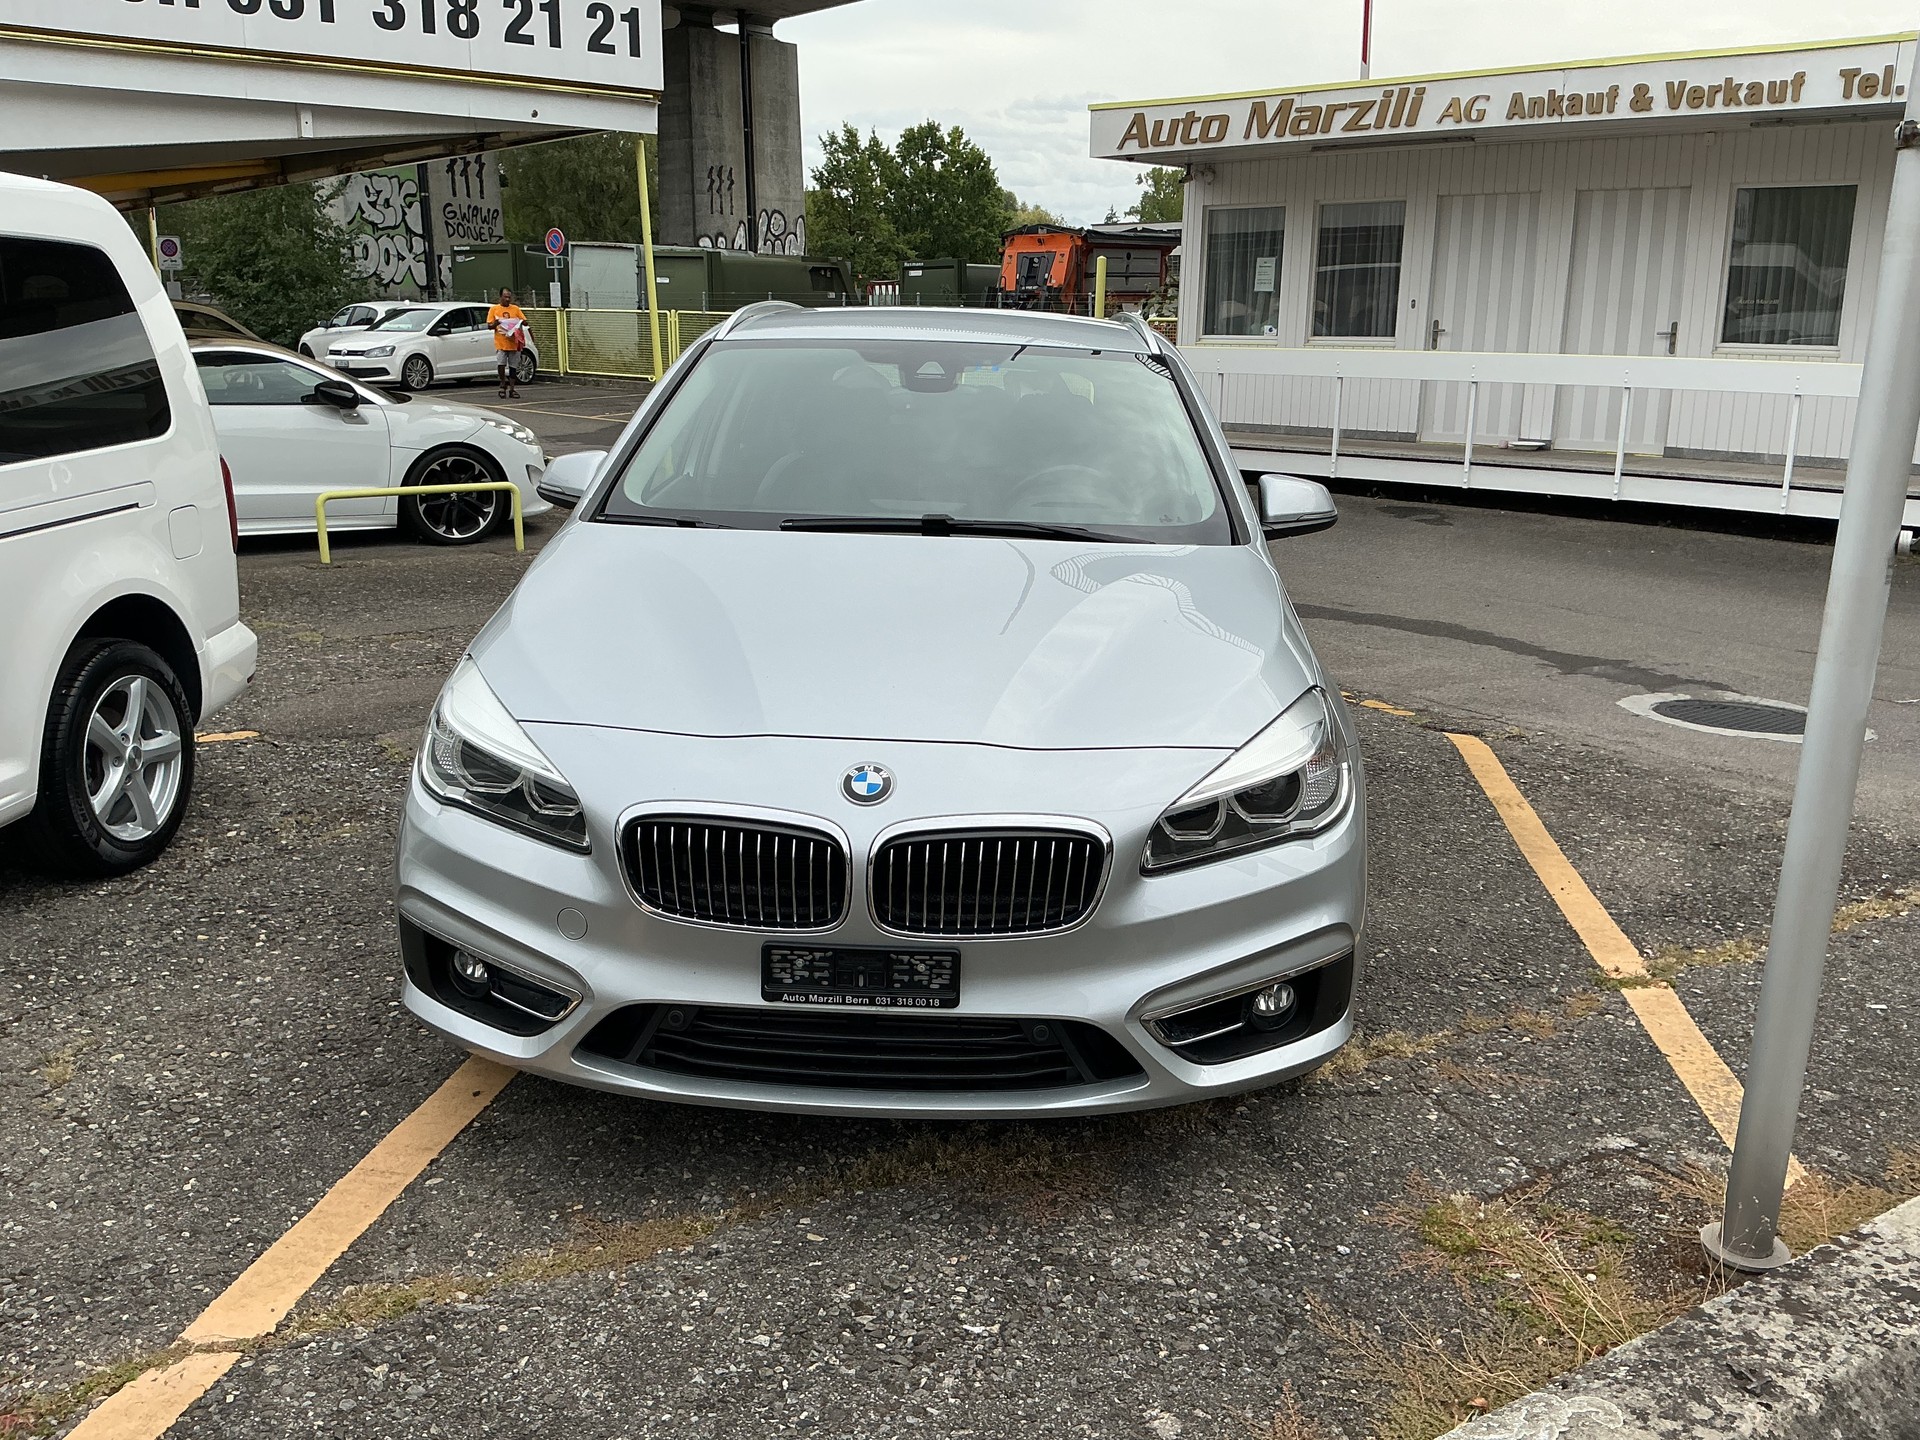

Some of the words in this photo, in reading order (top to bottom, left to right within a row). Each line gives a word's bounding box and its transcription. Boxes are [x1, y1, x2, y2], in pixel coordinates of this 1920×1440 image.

[372, 0, 480, 39] 318
[503, 0, 562, 49] 21
[586, 2, 641, 58] 21
[1116, 110, 1230, 150] Auto
[1243, 87, 1427, 139] Marzili
[1436, 94, 1490, 125] AG
[1506, 84, 1620, 120] Ankauf
[1629, 83, 1653, 113] &
[1665, 71, 1806, 110] Verkauf
[1839, 64, 1905, 99] Tel.
[848, 765, 890, 779] BMW
[782, 993, 806, 1002] Auto
[808, 994, 843, 1004] Marzili
[845, 995, 870, 1005] Bern
[915, 998, 927, 1007] 00
[929, 998, 940, 1007] 18
